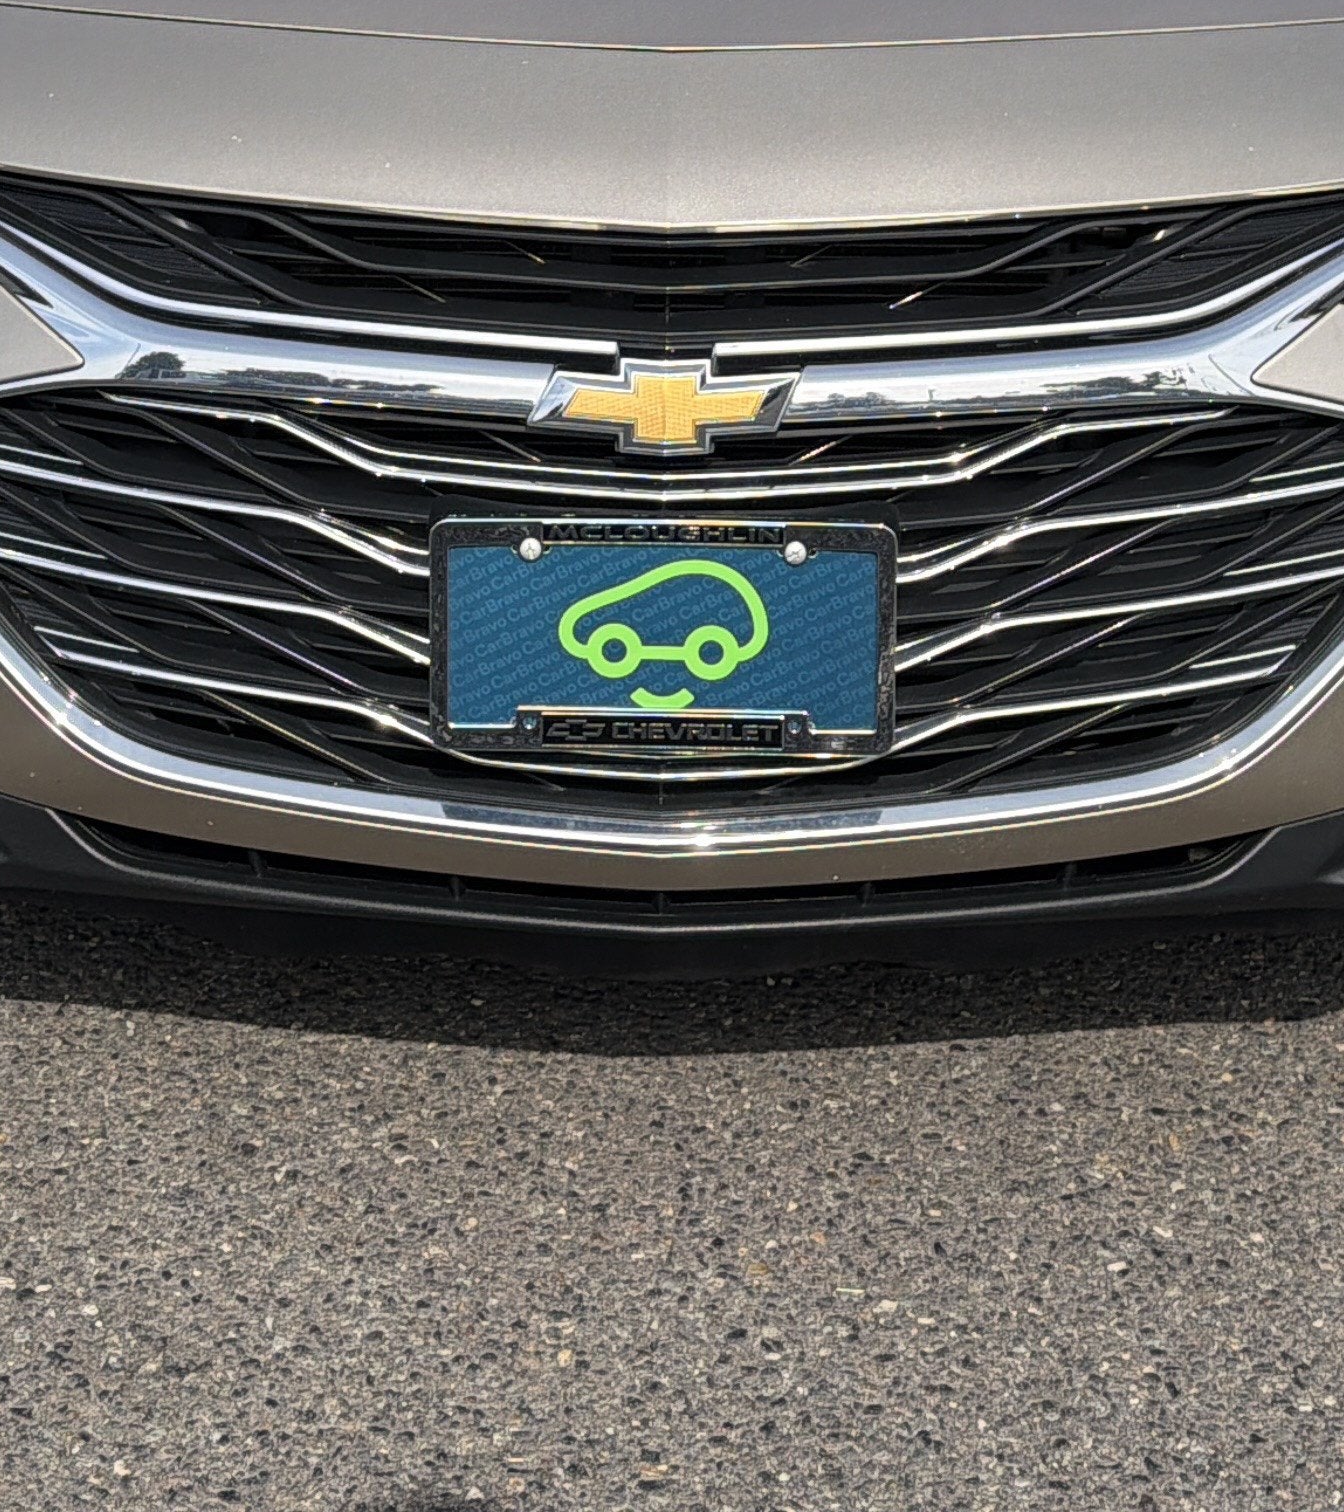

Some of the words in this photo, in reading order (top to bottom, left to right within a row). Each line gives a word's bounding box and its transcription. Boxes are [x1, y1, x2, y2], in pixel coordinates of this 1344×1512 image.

[530, 552, 599, 591] CarBravo
[577, 550, 648, 588] CarBravo
[459, 587, 530, 625] CarBravo
[506, 583, 577, 622] CarBravo
[631, 584, 702, 622] CarBravo
[679, 589, 734, 620] CarBra
[805, 584, 875, 621] CarBravo
[474, 619, 545, 658] CarBravo
[782, 614, 852, 651] CarBravo
[491, 651, 561, 689] CarBravo
[750, 649, 820, 687] CarBravo
[798, 646, 868, 685] CarBravo
[468, 681, 538, 719] CarBravo
[611, 721, 779, 742] CHEVROLET
